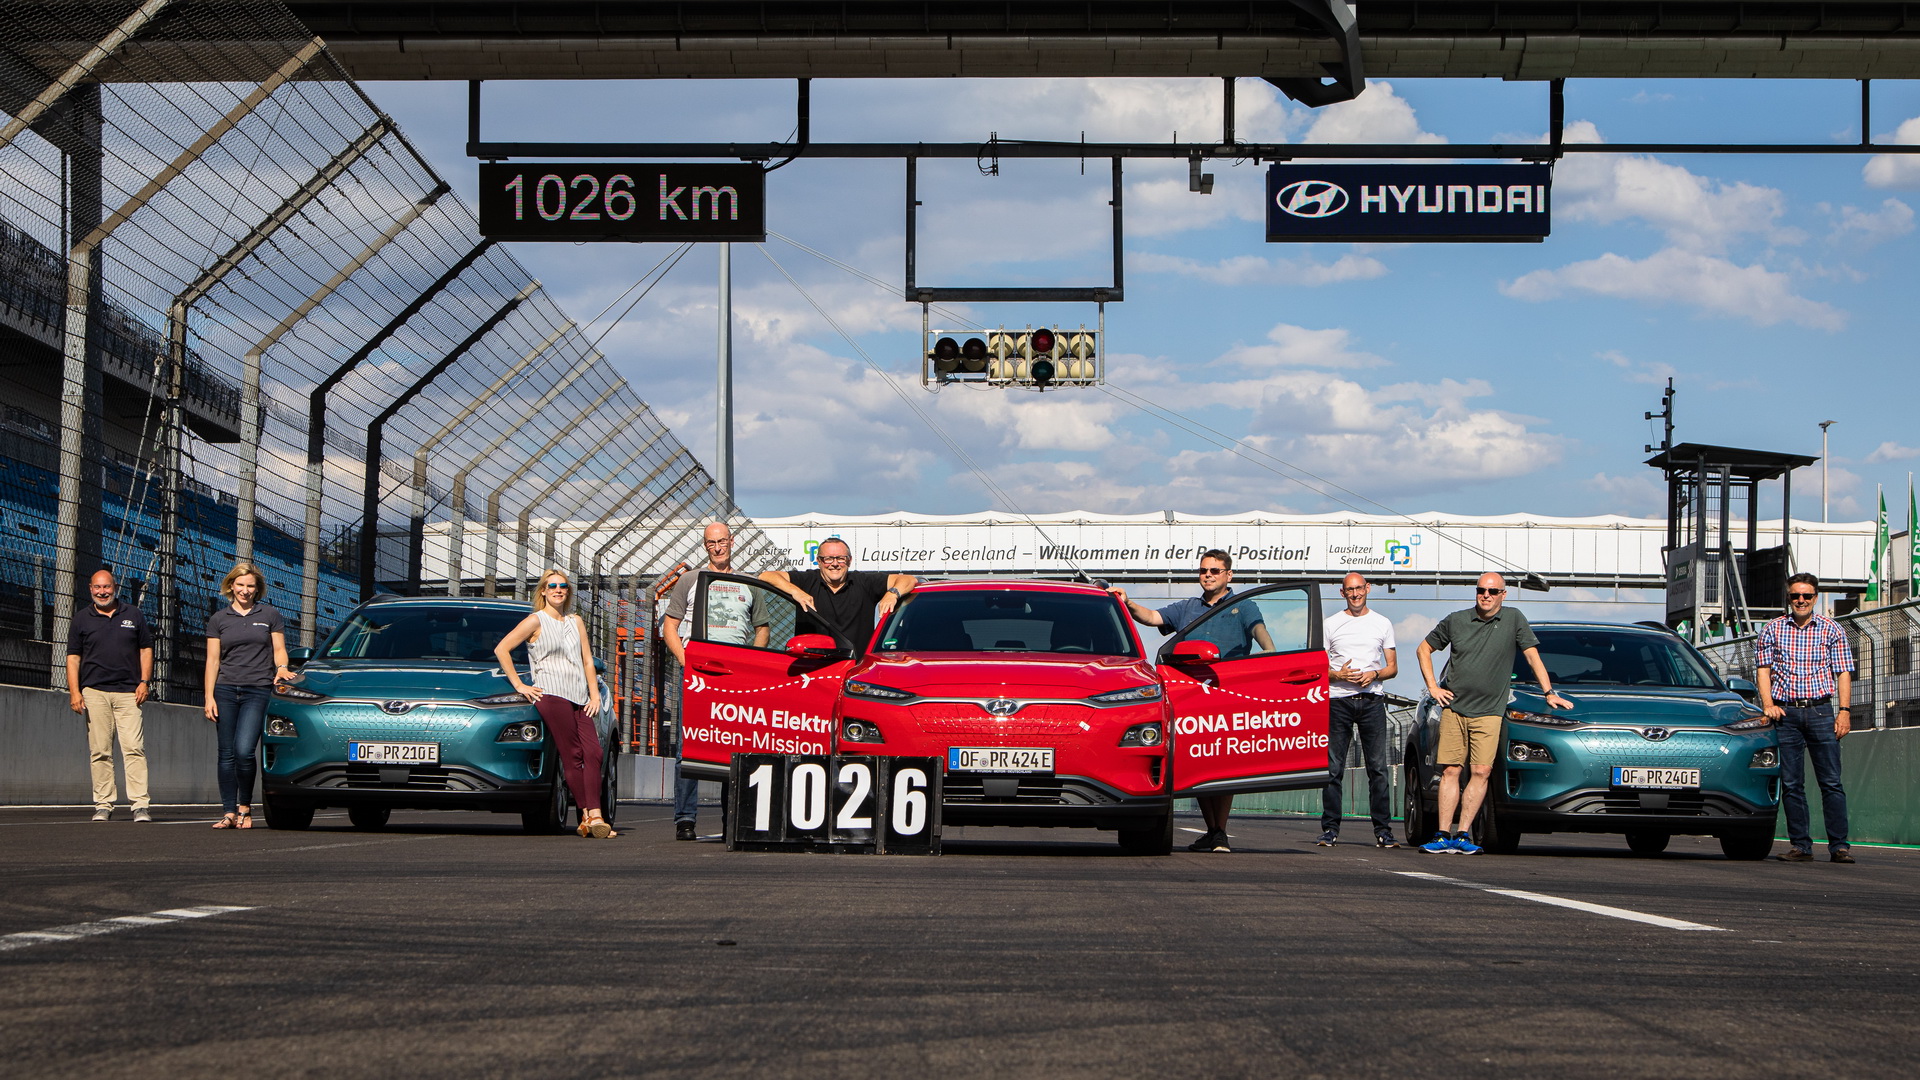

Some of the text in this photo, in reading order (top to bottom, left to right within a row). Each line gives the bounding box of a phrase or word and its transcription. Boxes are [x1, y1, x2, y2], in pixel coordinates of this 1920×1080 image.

[505, 174, 738, 220] 1026 km
[1361, 185, 1544, 213] HYUNDAI
[862, 547, 936, 562] Lausitzer
[941, 546, 1017, 561] Seenland
[1039, 545, 1140, 561] Willkommen
[1145, 545, 1160, 560] in
[1164, 545, 1193, 561] der
[1196, 546, 1311, 561] Pl-Position!
[1329, 545, 1373, 554] Lausitzer
[1340, 556, 1385, 566] Seenland
[711, 702, 768, 726] KONA
[1232, 711, 1302, 731] Elektro
[359, 745, 374, 759] OF
[384, 746, 399, 760] PR
[1189, 731, 1329, 758] auf Reichweite
[961, 751, 979, 767] OF
[990, 752, 1008, 767] PR
[1622, 770, 1638, 783] OF
[1647, 770, 1662, 784] PR
